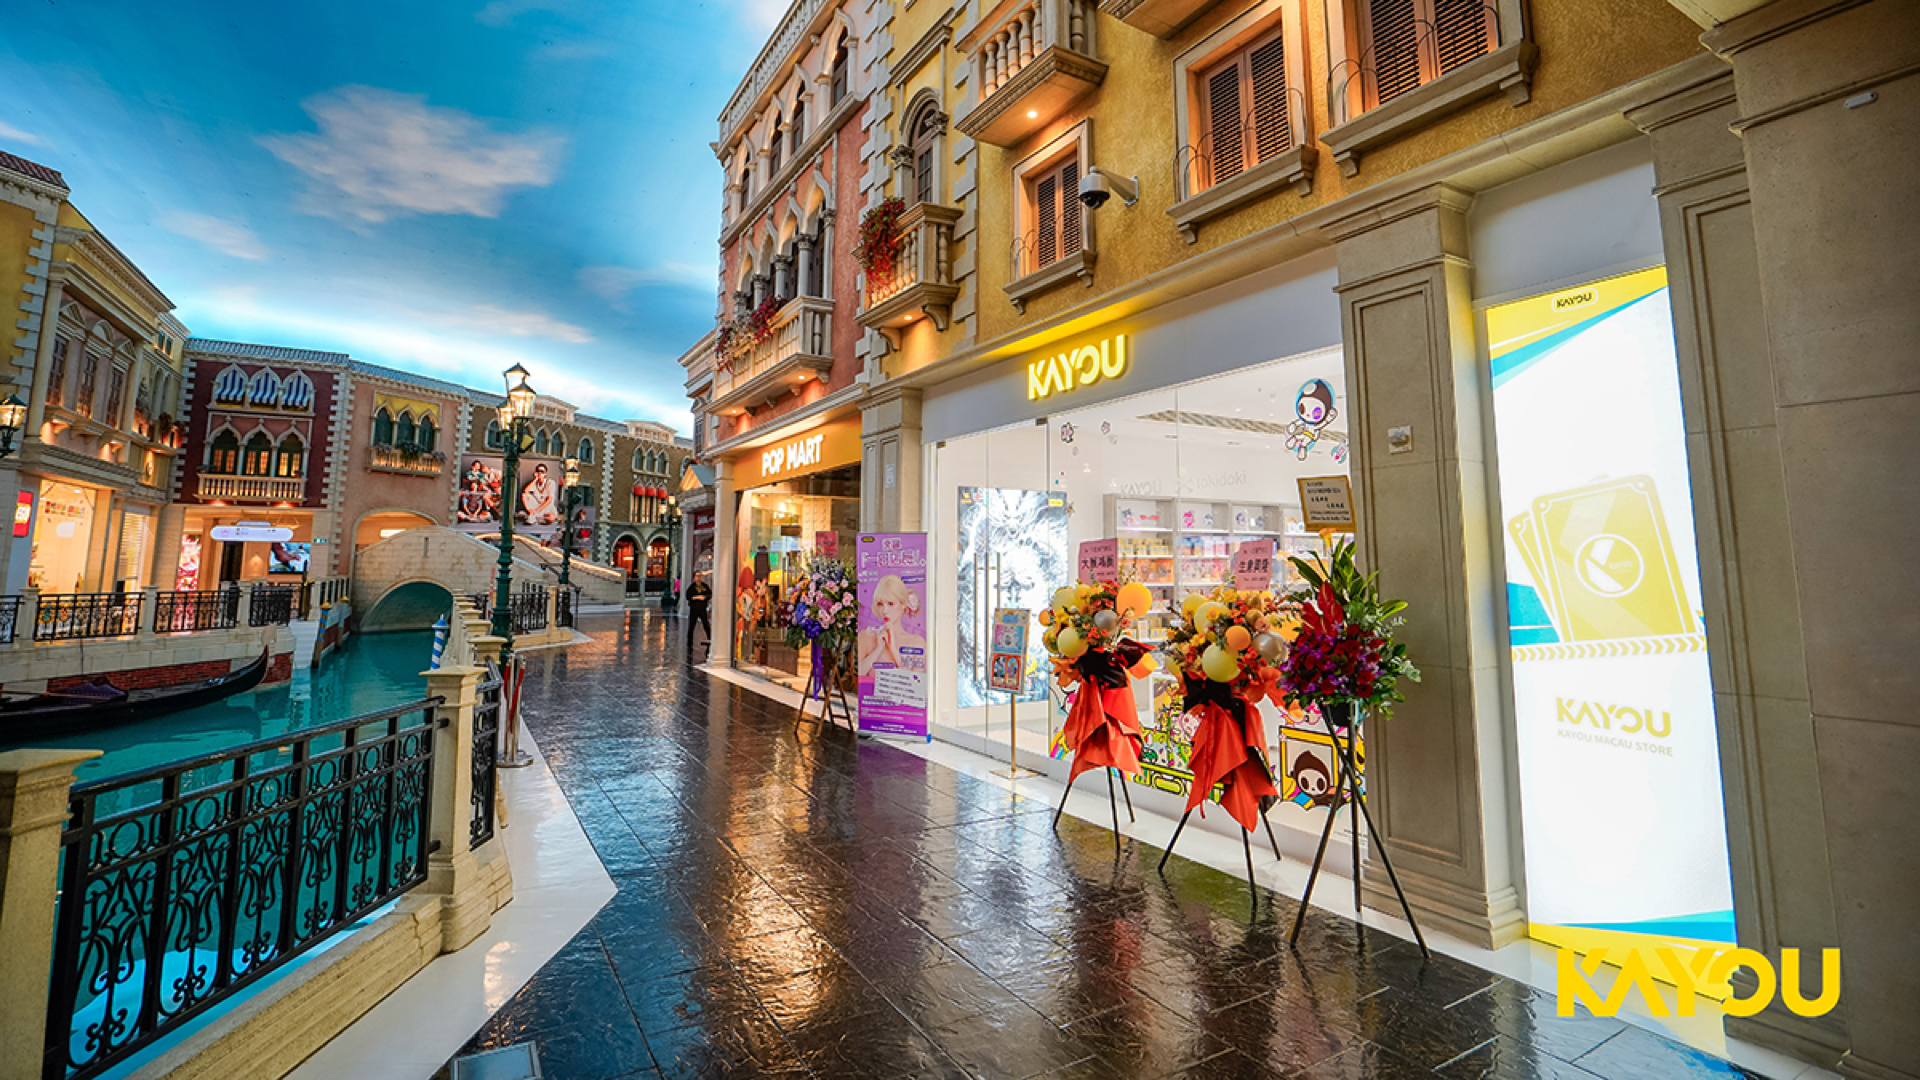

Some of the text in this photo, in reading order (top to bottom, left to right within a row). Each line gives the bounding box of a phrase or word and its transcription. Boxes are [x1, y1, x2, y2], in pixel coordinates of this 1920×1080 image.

[1556, 292, 1593, 308] KAYOU
[1028, 333, 1126, 400] KAYOU
[761, 433, 824, 478] POP MART
[1196, 469, 1247, 489] tokidoki
[1556, 697, 1671, 738] KAYOU
[1557, 728, 1673, 757] KAYOU MACAU STORE
